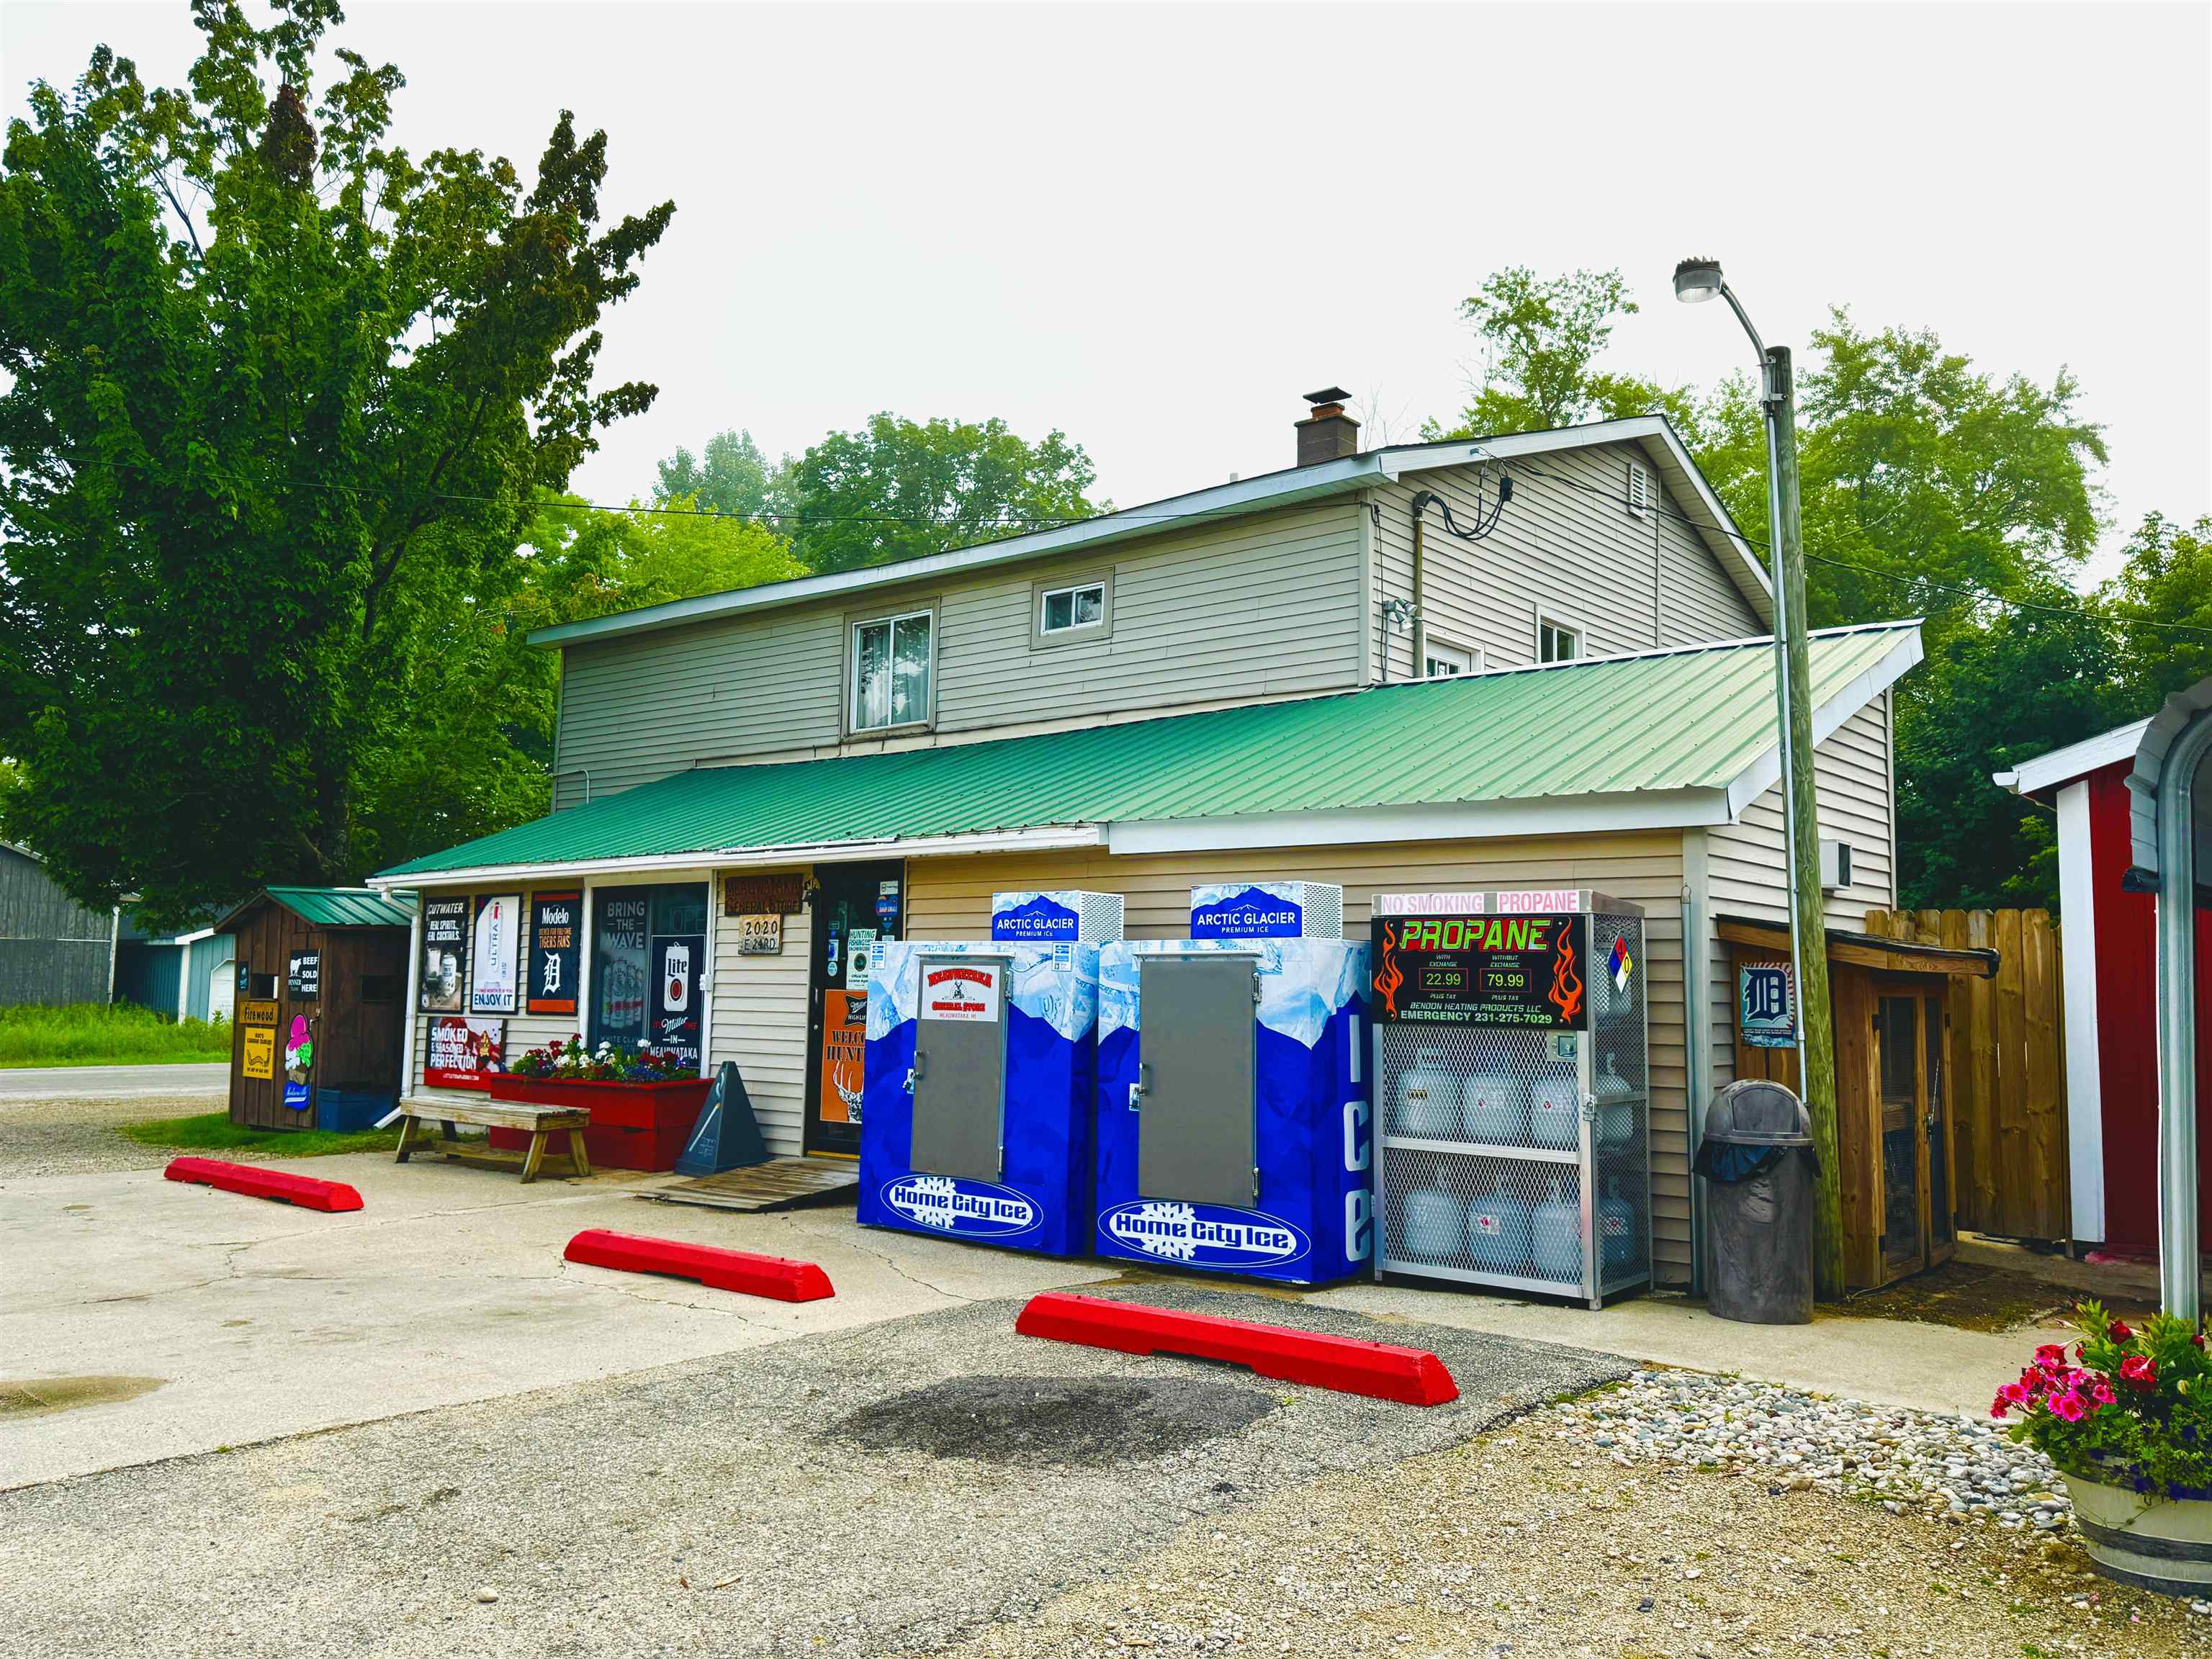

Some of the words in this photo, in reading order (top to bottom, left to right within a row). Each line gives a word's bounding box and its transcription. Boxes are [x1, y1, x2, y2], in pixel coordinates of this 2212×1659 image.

[607, 901, 645, 917] BRING
[1382, 895, 1404, 914] NO
[1408, 894, 1483, 913] SMOKING
[1499, 892, 1577, 912] PROPANE
[541, 907, 569, 924] Modelo
[1197, 914, 1240, 925] ARCTIC
[1244, 912, 1295, 924] GLACIER
[616, 919, 634, 930] THE
[745, 921, 778, 935] 2020
[997, 919, 1031, 929] ARCTIC
[1033, 918, 1074, 929] GLACIER
[606, 932, 644, 948] WAVE
[850, 930, 876, 938] HUNTING
[1400, 920, 1551, 950] PROPANE
[667, 958, 687, 977] Lite
[1624, 956, 1629, 974] 0
[302, 970, 317, 979] SOLD
[1426, 974, 1461, 985] 22.99
[1487, 974, 1524, 986] 79.99
[301, 984, 317, 992] HERE
[475, 994, 501, 1006] ENJOY
[504, 994, 513, 1006] IT
[1410, 1002, 1443, 1010] BENDON
[1480, 1004, 1525, 1012] PRODUCTS
[245, 1007, 274, 1021] Firewood
[1401, 1010, 1471, 1022] EMERGENCY
[1475, 1012, 1553, 1024] 231-275-7029
[661, 1017, 689, 1034] Miller
[431, 1026, 468, 1043] SMOKED
[670, 1035, 678, 1044] IN
[430, 1053, 477, 1071] PERFECTION
[894, 1187, 948, 1208] Home
[952, 1195, 991, 1218] City
[994, 1200, 1028, 1220] Ice
[1116, 1214, 1187, 1238] Home
[1192, 1222, 1241, 1247] City
[1246, 1227, 1289, 1249] Ice
